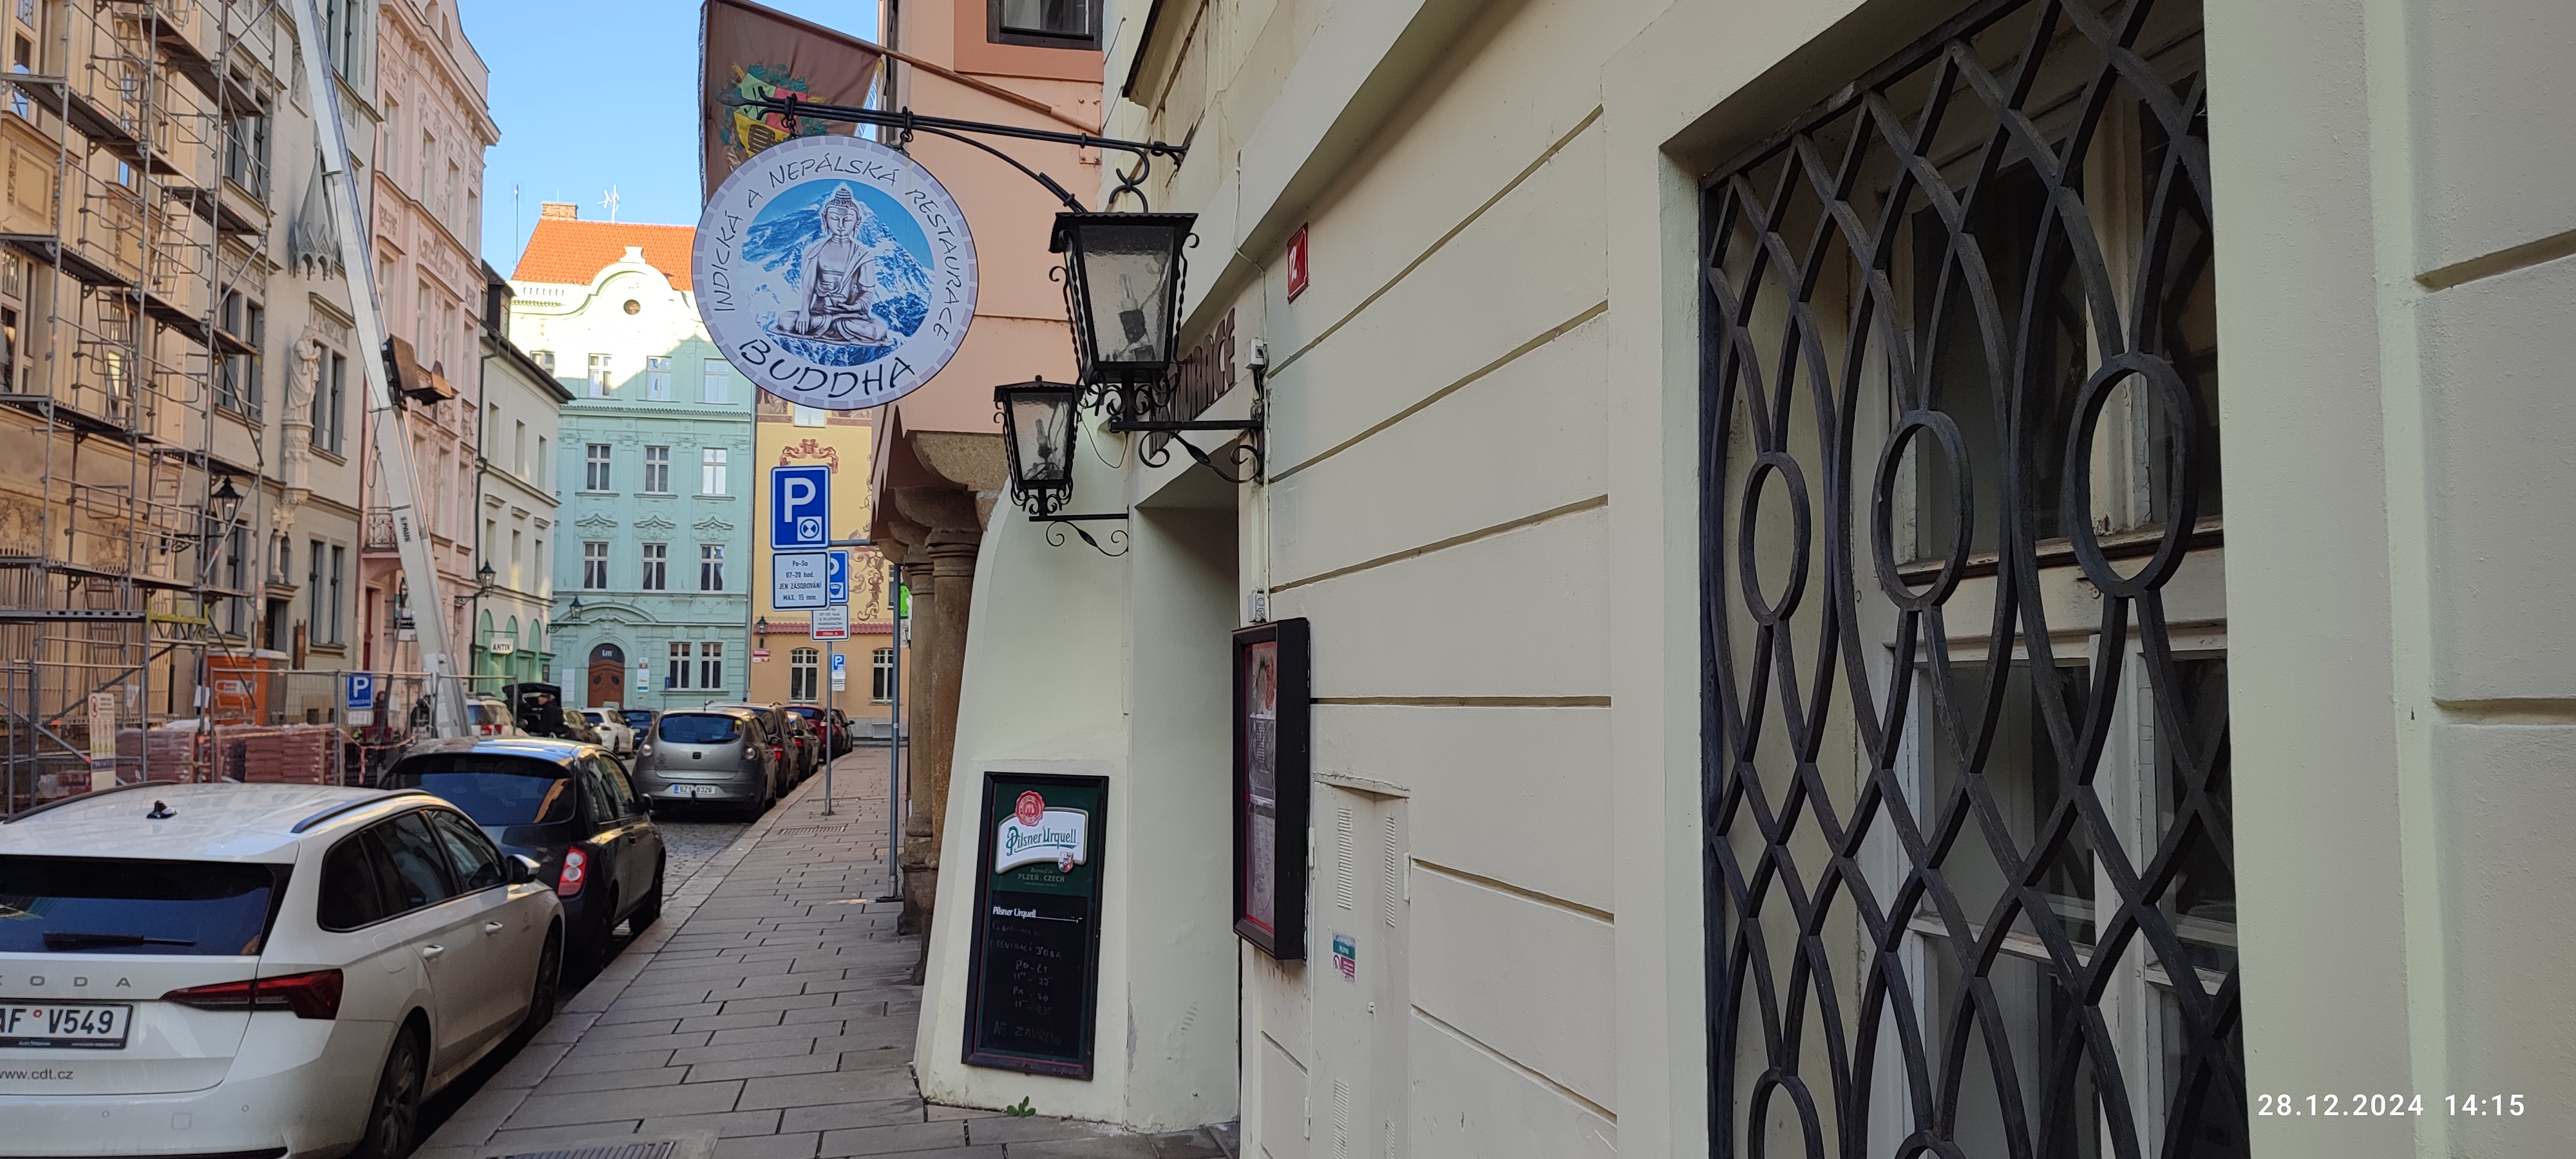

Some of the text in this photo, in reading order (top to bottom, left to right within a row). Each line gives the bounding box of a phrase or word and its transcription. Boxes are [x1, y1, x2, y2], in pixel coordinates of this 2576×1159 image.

[714, 152, 962, 341] INDICKÁ A NEPÁLSKÁ RESTAURACE
[738, 339, 915, 398] BUDDHA
[784, 477, 817, 523] P
[790, 581, 822, 590] ZÁSOBOVÁNÍ
[835, 655, 842, 666] P
[354, 676, 369, 698] P
[1005, 824, 1077, 857] Pilsner Urquell
[1043, 874, 1065, 883] CZECH
[992, 906, 1037, 919] Pilsner Urquell
[0, 975, 131, 988] ODA
[49, 1009, 113, 1034] V549
